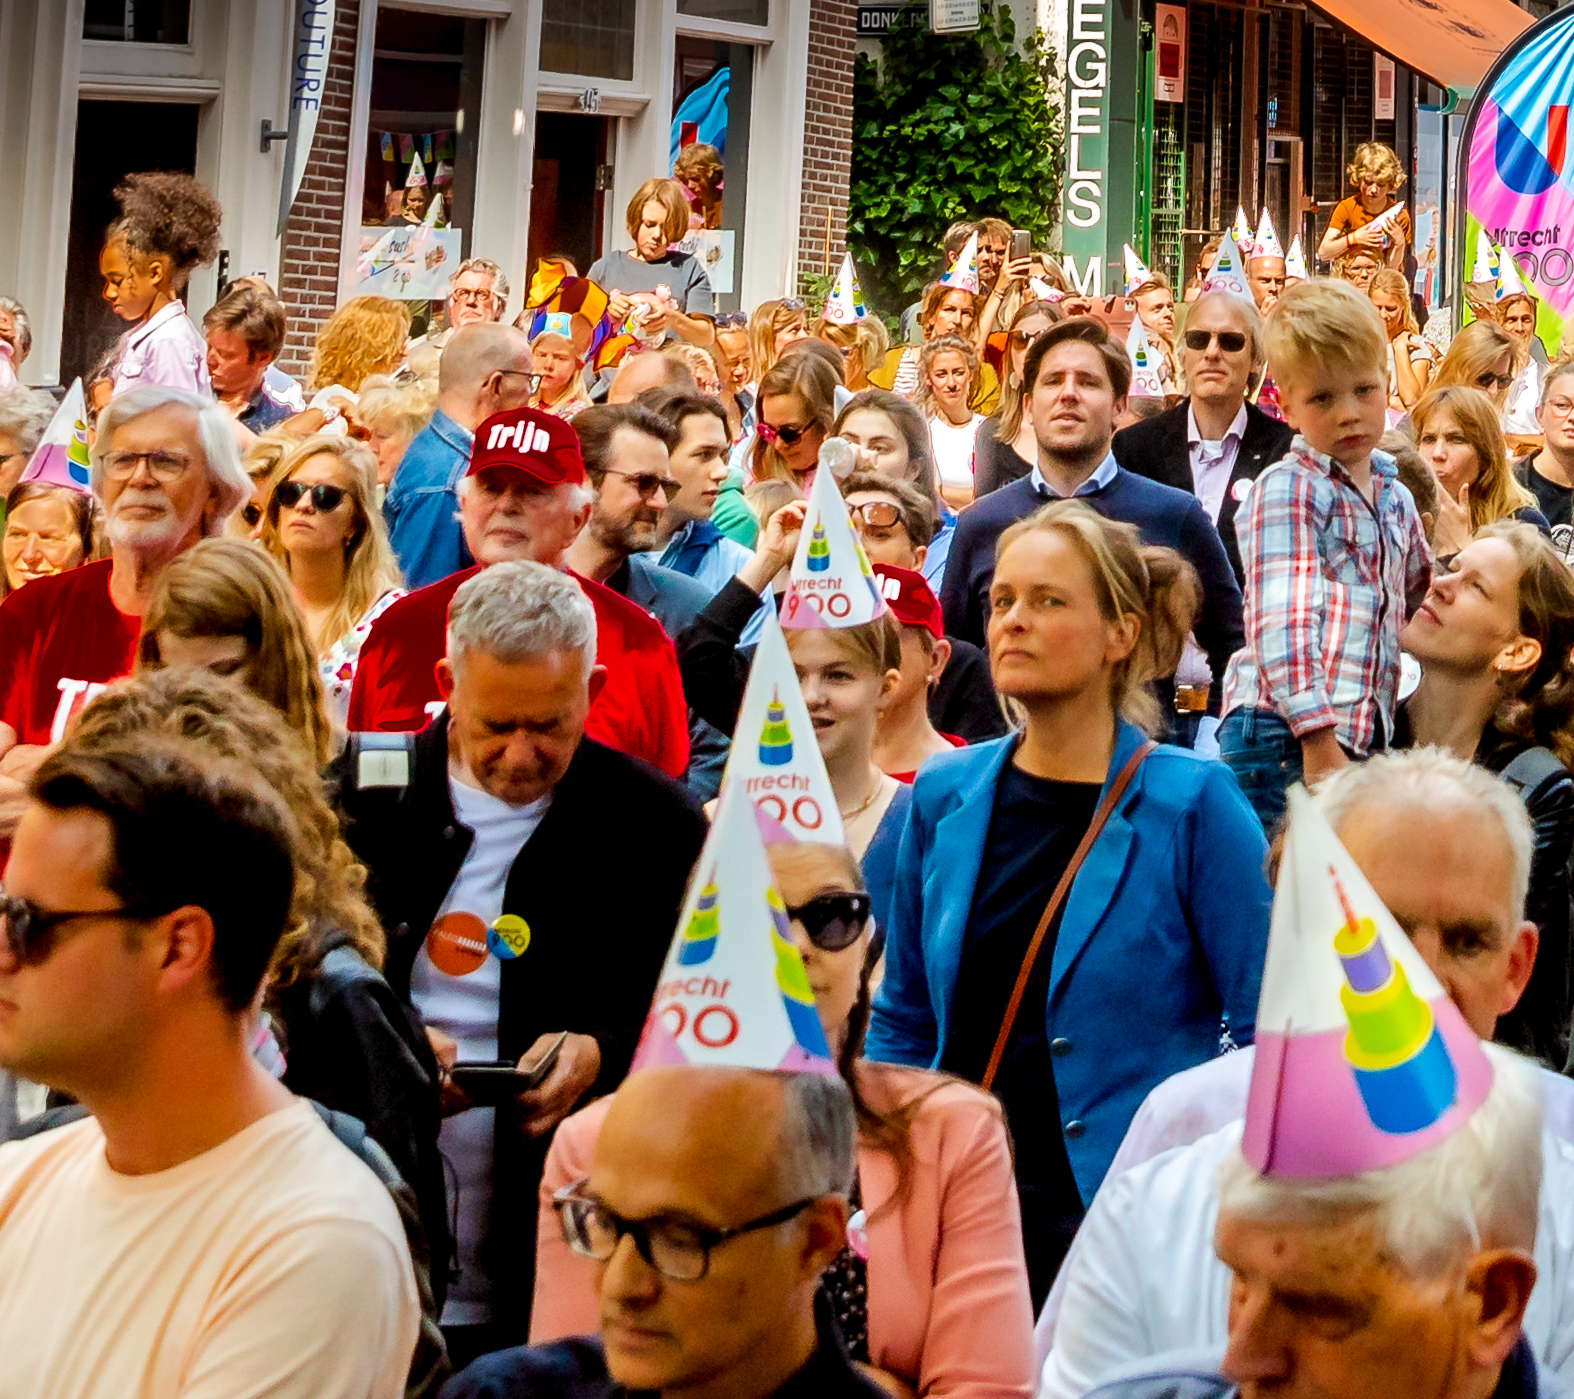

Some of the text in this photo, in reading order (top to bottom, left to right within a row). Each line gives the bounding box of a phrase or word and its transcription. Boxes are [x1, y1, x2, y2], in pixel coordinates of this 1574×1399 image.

[1492, 247, 1574, 288] 00
[1135, 377, 1159, 391] 00
[486, 420, 551, 454] Trijn
[787, 592, 852, 621] 900
[756, 794, 823, 831] 00
[661, 1002, 741, 1050] 00
